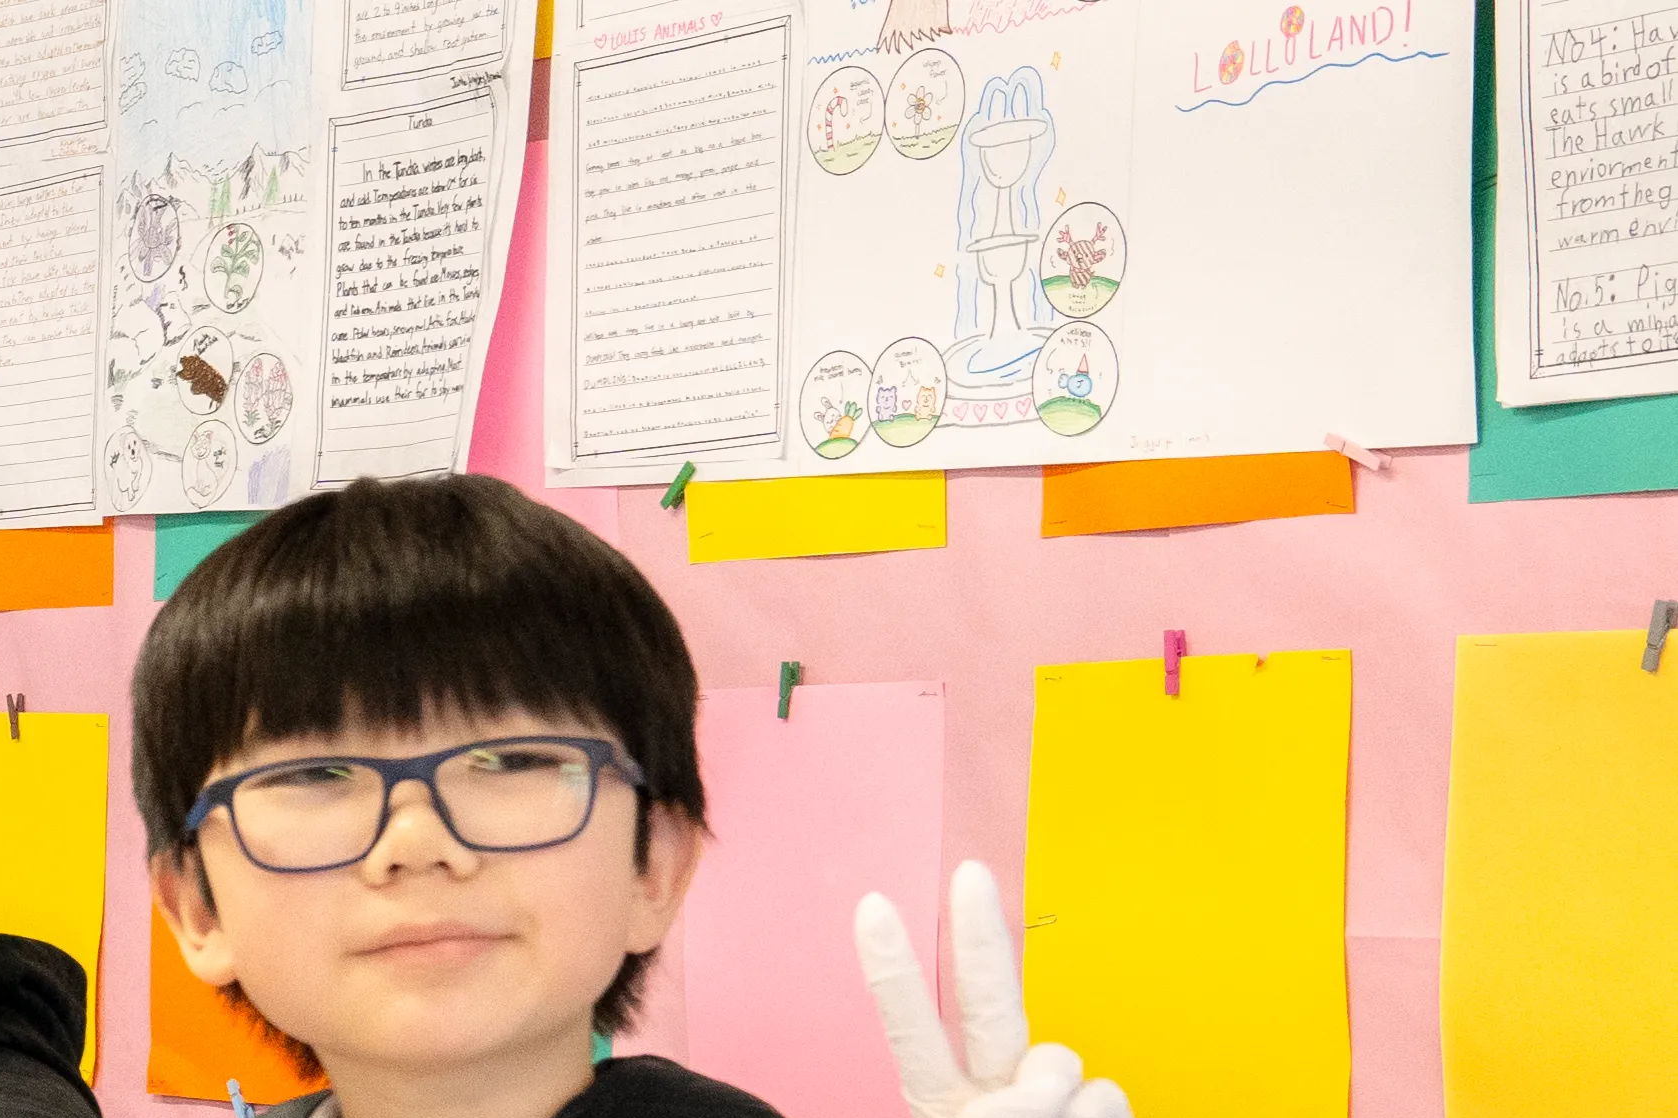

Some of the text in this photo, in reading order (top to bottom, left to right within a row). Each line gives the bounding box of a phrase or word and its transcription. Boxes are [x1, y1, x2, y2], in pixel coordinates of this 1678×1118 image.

[654, 17, 705, 40] ANIMALS
[1553, 73, 1568, 95] is
[1601, 54, 1641, 86] bird
[1550, 96, 1598, 124] eats
[1546, 112, 1665, 158] The Hawk
[363, 163, 372, 182] In
[378, 161, 391, 180] the
[340, 192, 354, 208] and
[339, 216, 347, 230] to
[349, 216, 360, 229] ten
[390, 214, 397, 224] in
[400, 207, 410, 221] the
[355, 233, 374, 249] found
[389, 233, 401, 245] the
[472, 216, 479, 229] to
[1558, 229, 1619, 249] warm
[376, 257, 382, 269] to
[387, 255, 397, 267] the
[336, 281, 358, 298] Plants
[362, 277, 378, 294] that
[400, 273, 408, 287] be
[407, 295, 422, 310] that
[438, 291, 445, 302] in
[449, 288, 459, 301] the
[1562, 316, 1581, 339] is
[1594, 319, 1612, 336] a
[366, 346, 382, 360] and
[332, 372, 340, 384] in
[345, 370, 358, 383] the
[403, 362, 412, 384] by
[376, 395, 390, 404] use
[395, 385, 412, 400] their
[416, 381, 428, 399] fur
